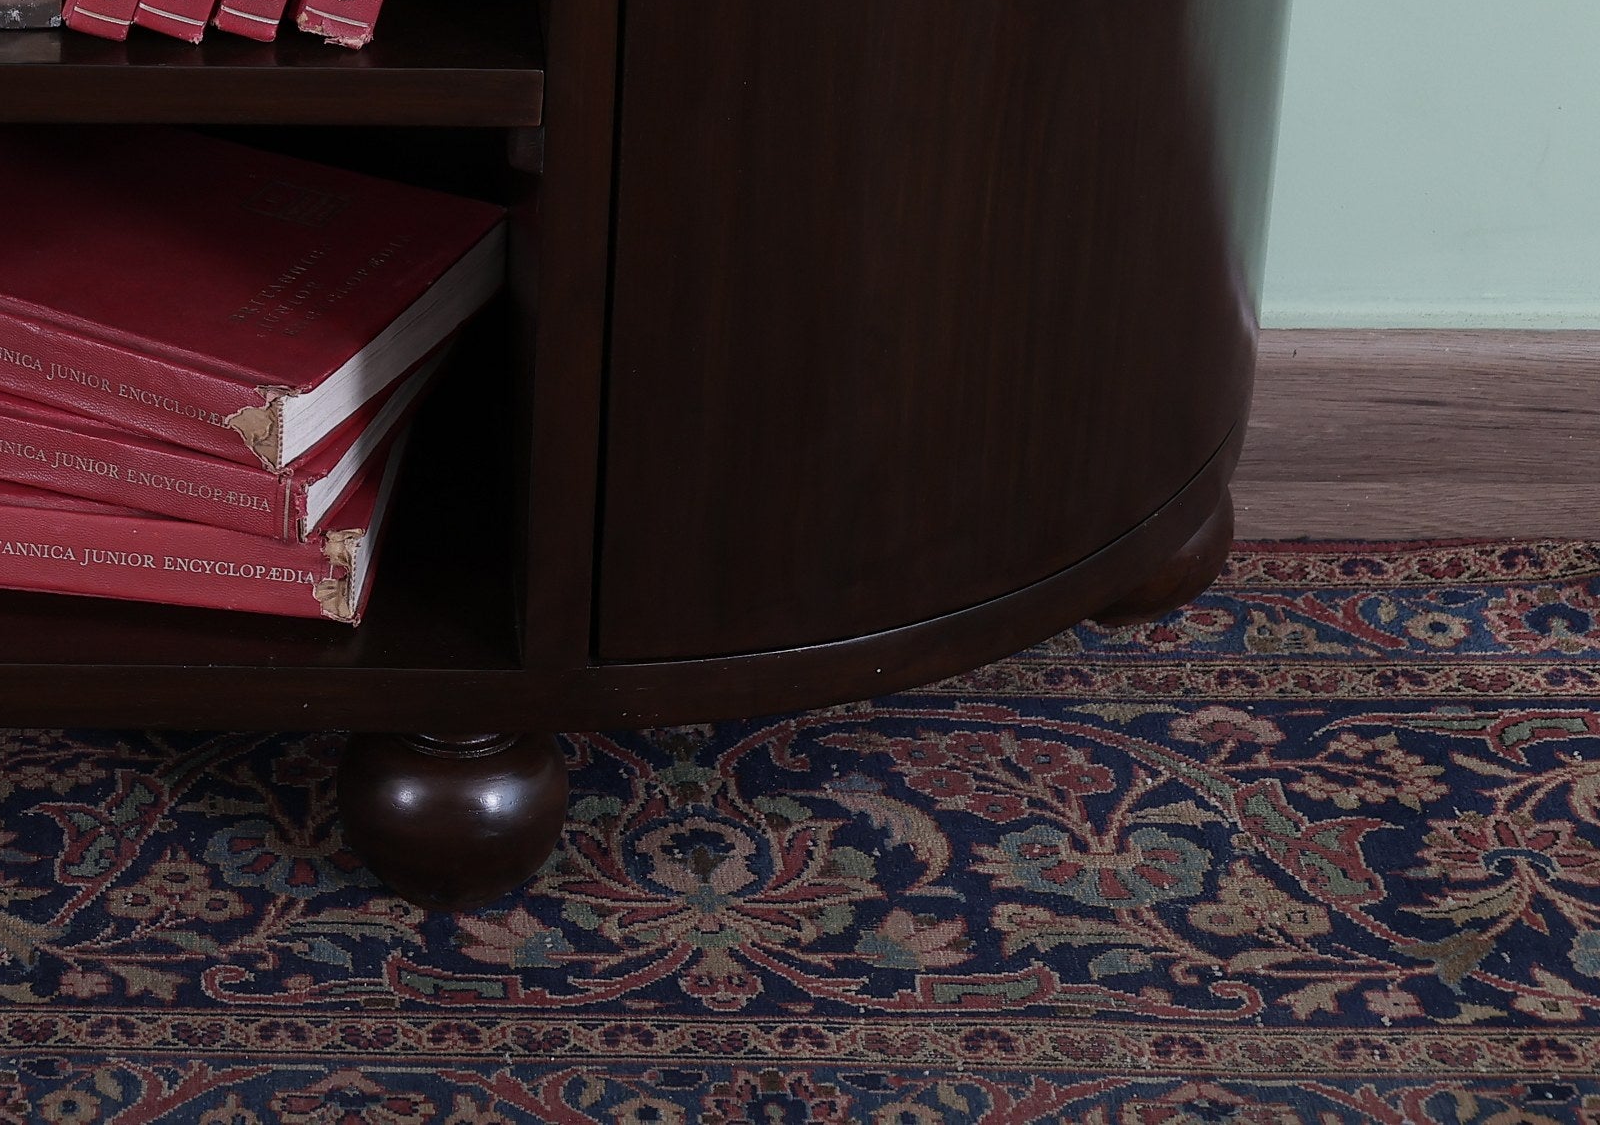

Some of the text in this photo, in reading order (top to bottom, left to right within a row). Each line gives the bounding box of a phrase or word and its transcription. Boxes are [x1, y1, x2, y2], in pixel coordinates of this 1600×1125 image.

[47, 363, 112, 394] JUNIOR
[119, 385, 230, 429] ENCYCLOPÆ
[51, 449, 120, 478] JUNIOR
[127, 468, 271, 512] ENCYCLOPÆDIA
[81, 548, 156, 570] JUNIOR
[164, 556, 315, 585] ENCYCLOPÆDIA
